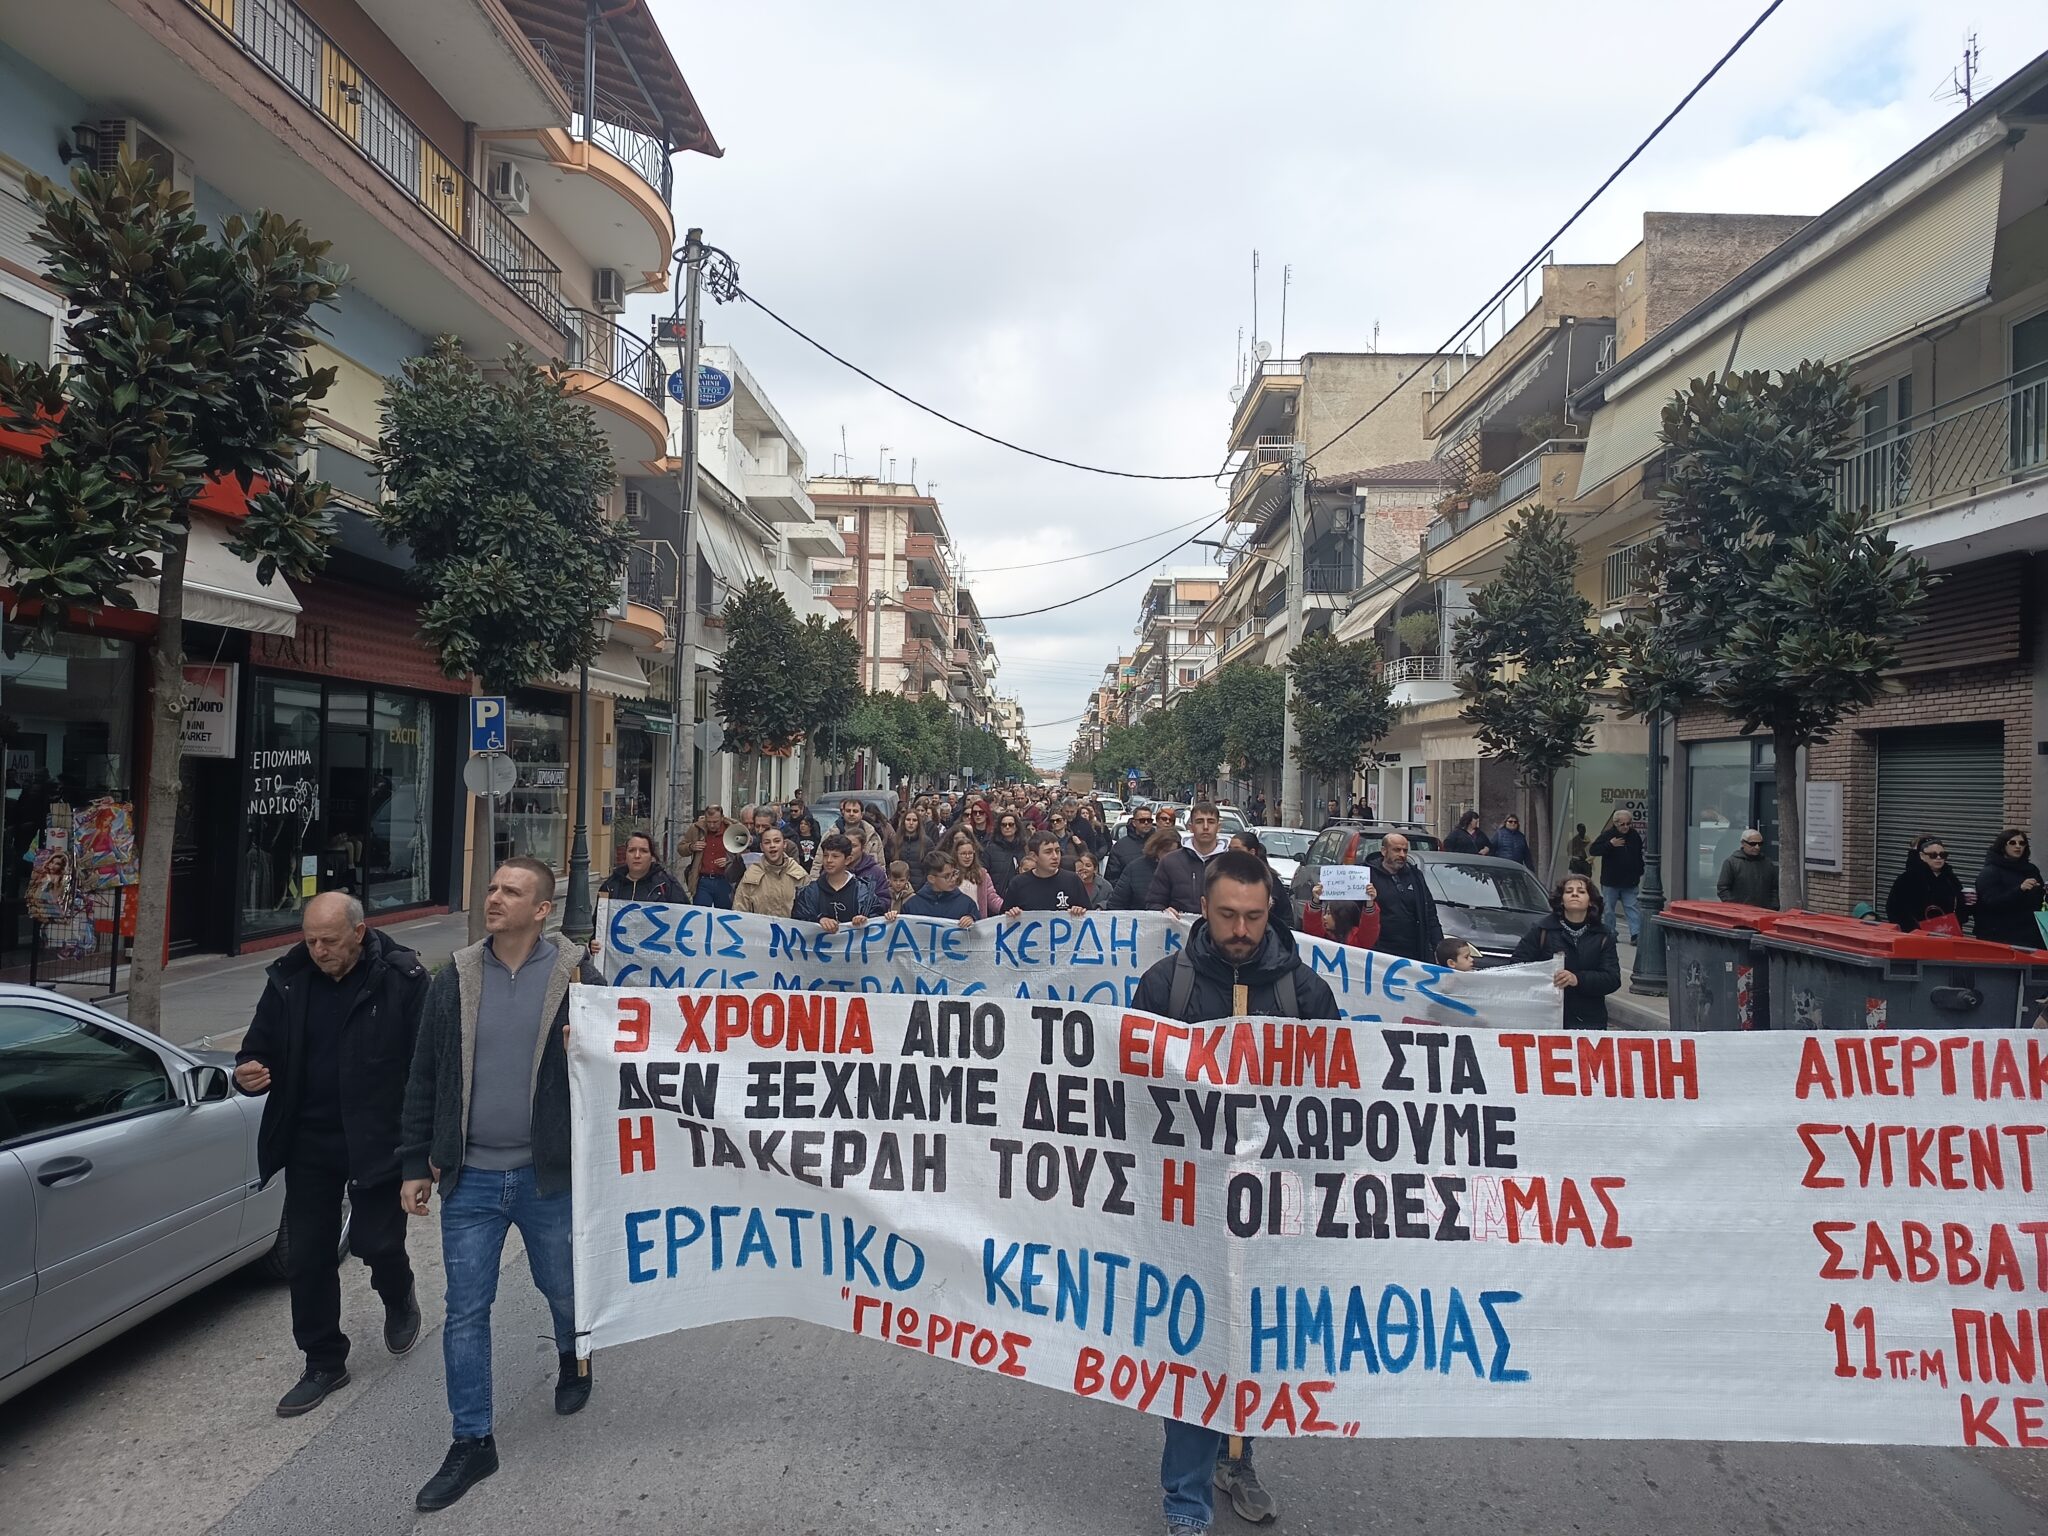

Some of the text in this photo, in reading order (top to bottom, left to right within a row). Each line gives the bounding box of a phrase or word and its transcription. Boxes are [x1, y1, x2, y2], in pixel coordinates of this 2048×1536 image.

[476, 700, 499, 728] P
[250, 749, 311, 769] ΕΠΟΥΛΗΜΑ
[255, 775, 282, 793] ΣΤΟ
[248, 797, 296, 815] ΝΔΡΙΚΟ
[1601, 788, 1648, 799] ΕΠΩΝΥΜ
[1626, 801, 1648, 809] ΟΛ
[611, 902, 746, 959] ΕΣΕΙΣ
[769, 918, 969, 965] ΜΕΤΡΑΤΕ
[995, 917, 1138, 968] ΚΕΡΔΗ
[1296, 943, 1477, 1017] ΜΙΕΣ
[614, 992, 1698, 1100] 3 ΧΡΟΝΙΑ ΑΠΟ ΤΟ ΕΓΚΛΗΜΑ ΣΤΑ ΤΕΜΠΗ
[618, 1060, 1518, 1169] ΔΕΝ ΞΕΧΝΑΜΕ ΔΕΝ ΣΥΓΧΩΡΟΥΜΕ
[617, 1116, 656, 1175] Η
[990, 1138, 1136, 1217] ΤΟΥΣ
[1162, 1158, 1196, 1227] Η
[1315, 1171, 1471, 1241] ΖΩΕΣ
[1502, 1175, 1633, 1249] ΜΑΣ
[1812, 1219, 2048, 1292] ΣΑΒΒΑΤ
[625, 1205, 1531, 1383] ΕΡΓΑΤΙΚΟ ΚΕΝΤΡΟ ΗΜΑΘΙΑΣ
[1960, 1393, 2048, 1448] ΚΕ
